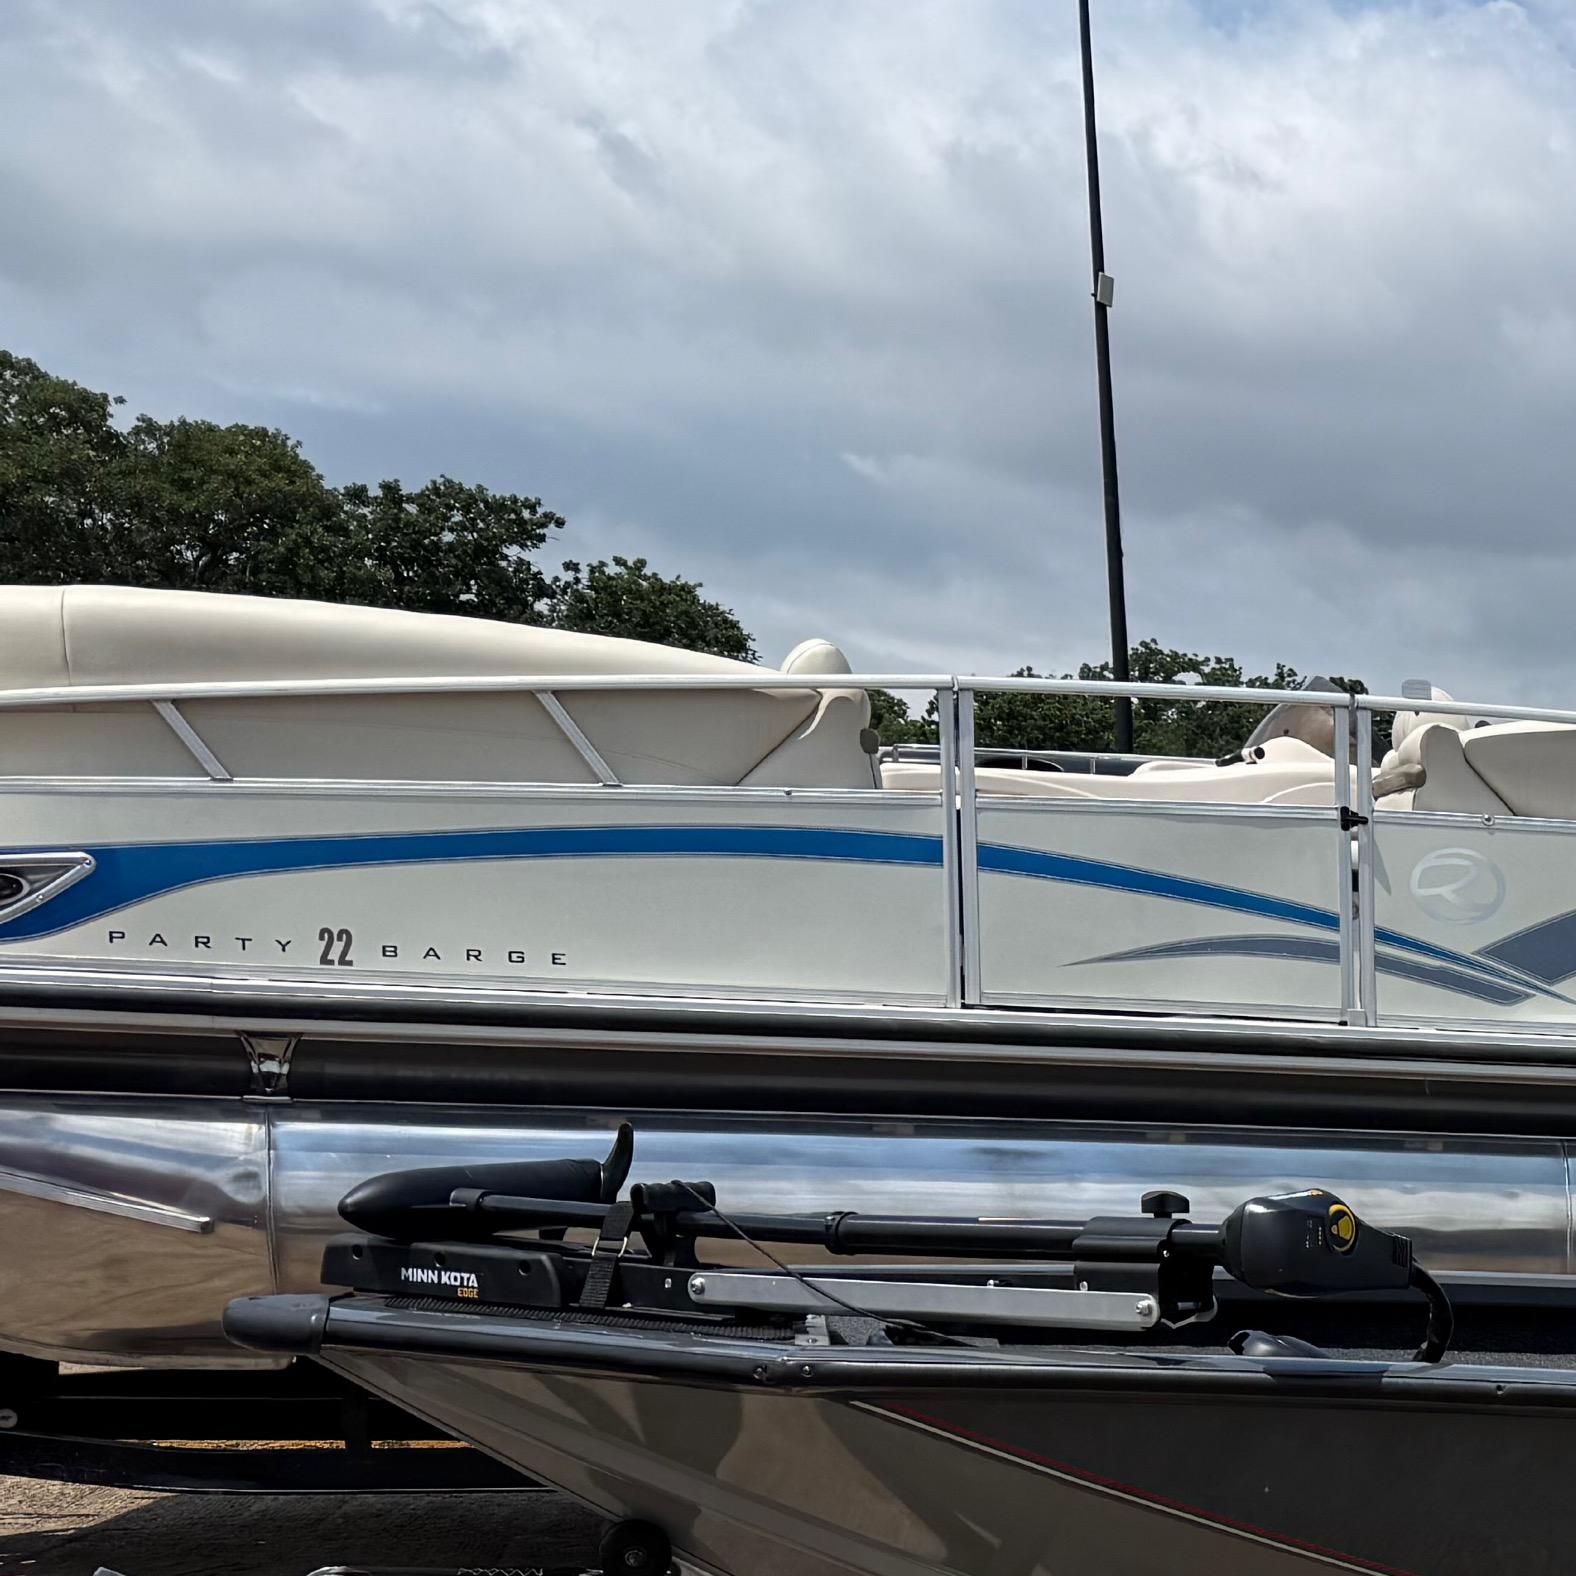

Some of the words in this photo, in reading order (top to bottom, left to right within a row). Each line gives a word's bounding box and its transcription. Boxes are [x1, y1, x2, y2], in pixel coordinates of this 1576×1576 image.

[108, 929, 293, 953] PARTY
[318, 926, 354, 967] 22
[381, 943, 567, 966] BARGE
[401, 1267, 438, 1284] MINN
[441, 1272, 478, 1287] KOTA
[457, 1288, 479, 1298] EDGE
